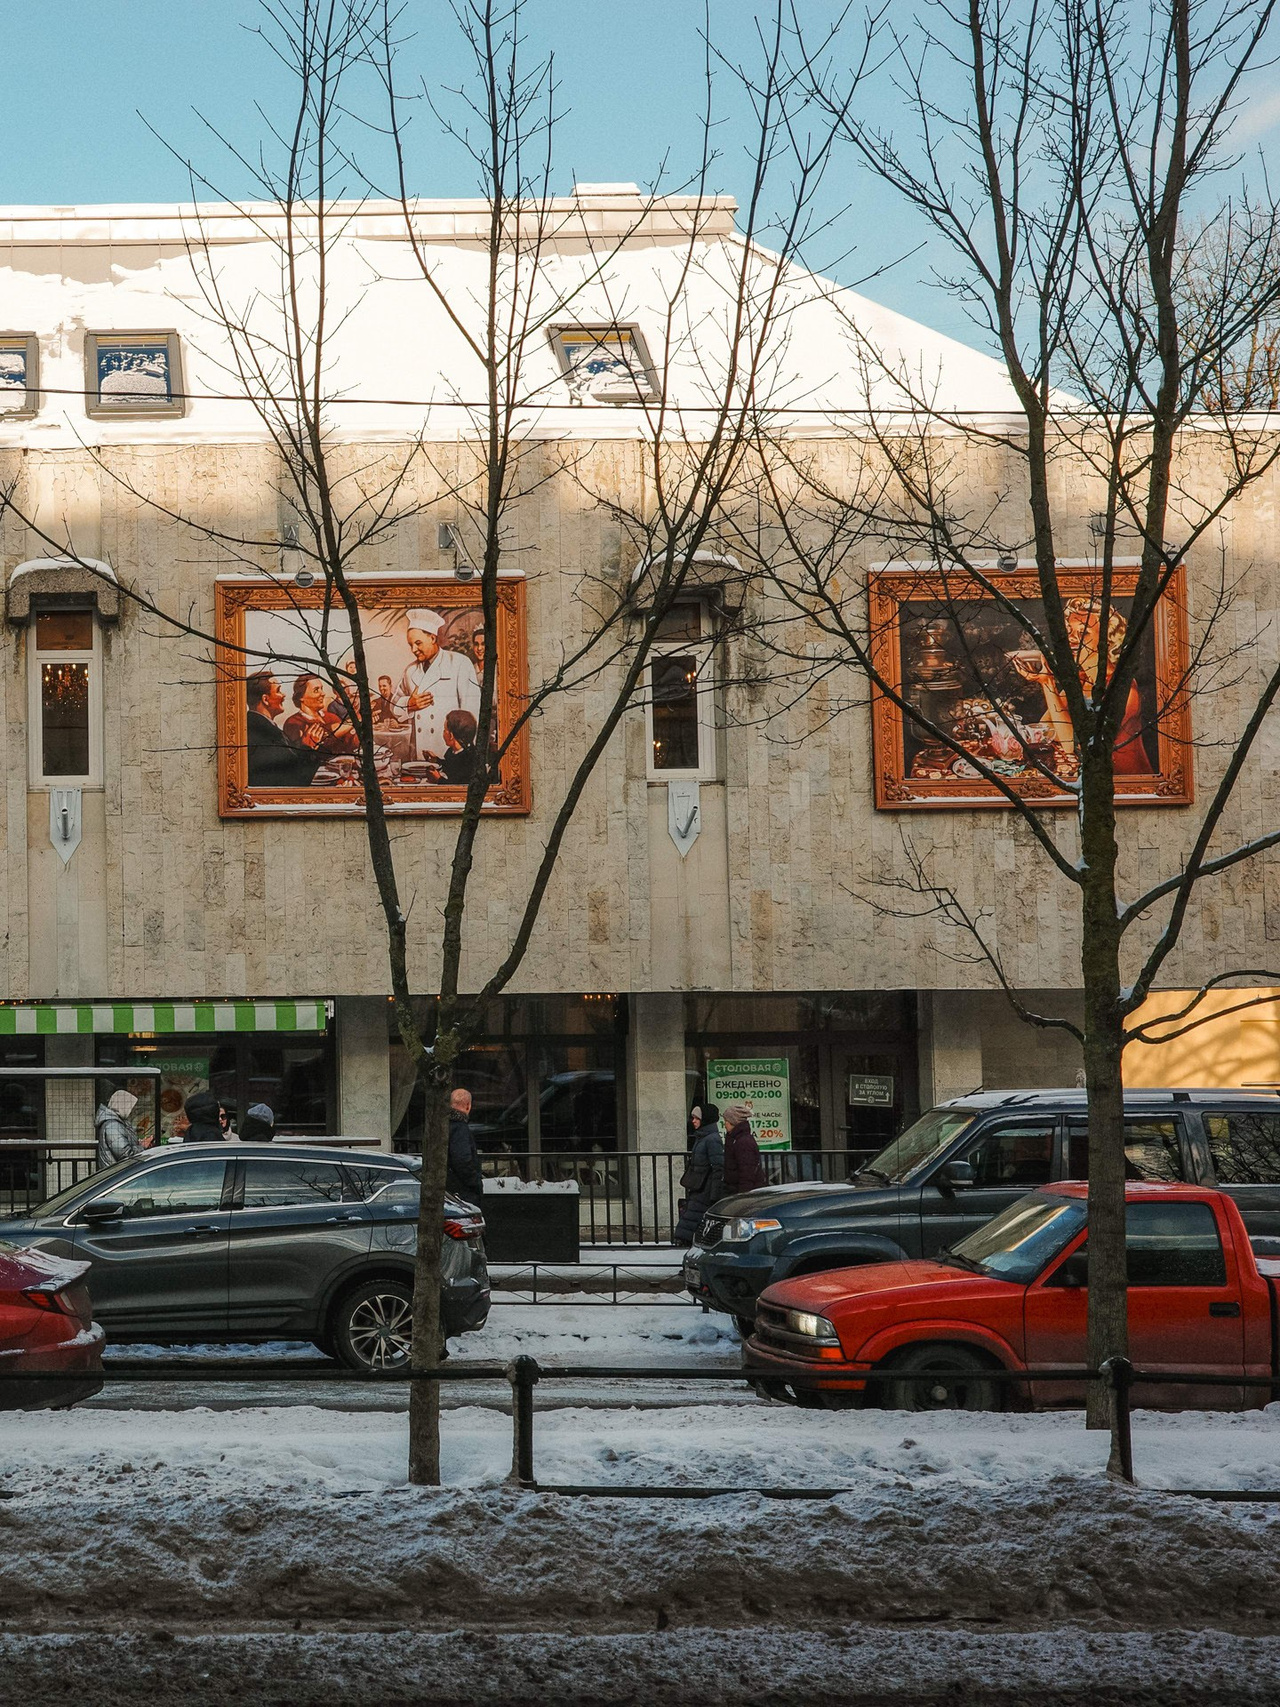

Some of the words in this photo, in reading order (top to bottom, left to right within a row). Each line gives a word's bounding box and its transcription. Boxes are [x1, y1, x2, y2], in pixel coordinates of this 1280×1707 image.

[714, 1064, 771, 1073] СТОЛОВАЯ
[715, 1080, 782, 1090] ЕЖЕДНЕВНО
[715, 1090, 782, 1099] 09:00-20:00
[760, 1129, 784, 1138] 20%
